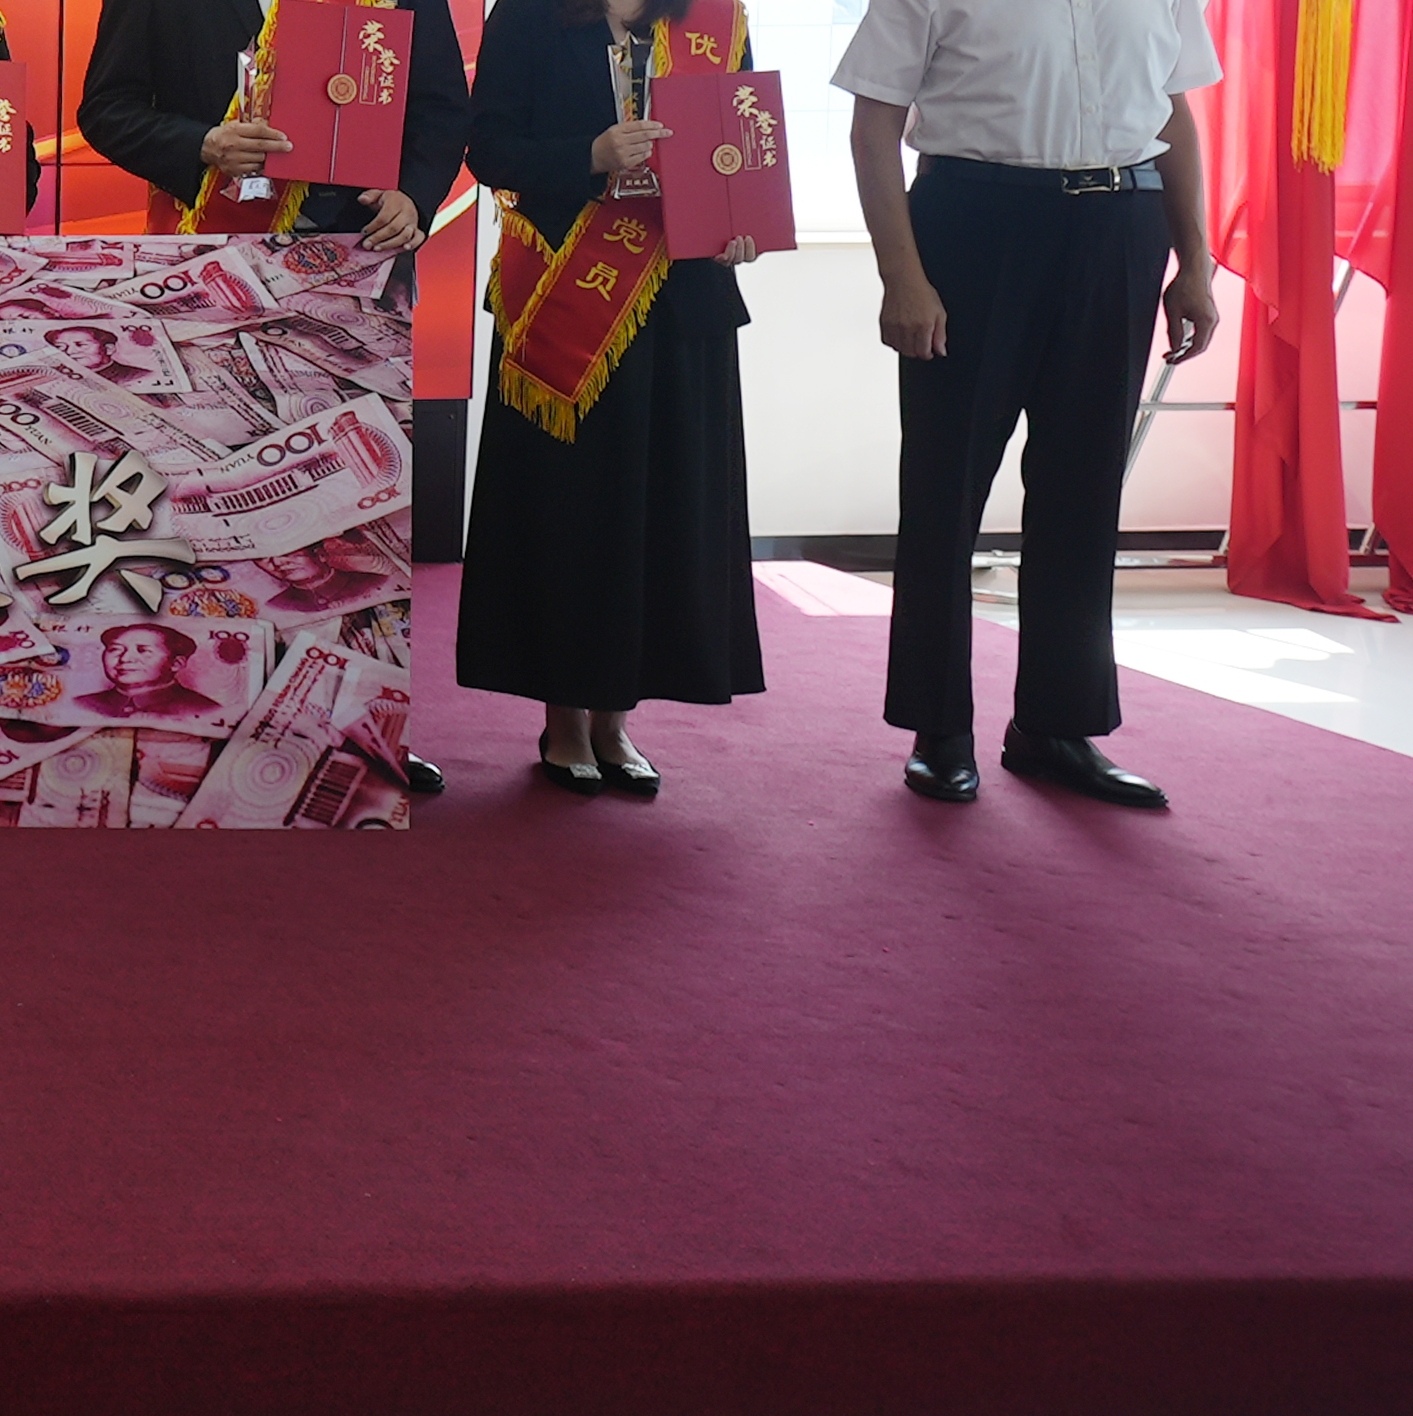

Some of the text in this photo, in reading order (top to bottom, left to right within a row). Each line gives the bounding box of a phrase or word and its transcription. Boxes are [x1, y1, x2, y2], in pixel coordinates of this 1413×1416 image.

[576, 217, 648, 302] 党员
[139, 269, 200, 299] 100
[257, 423, 328, 467] 100
[207, 630, 249, 642] 100
[305, 647, 347, 669] 100
